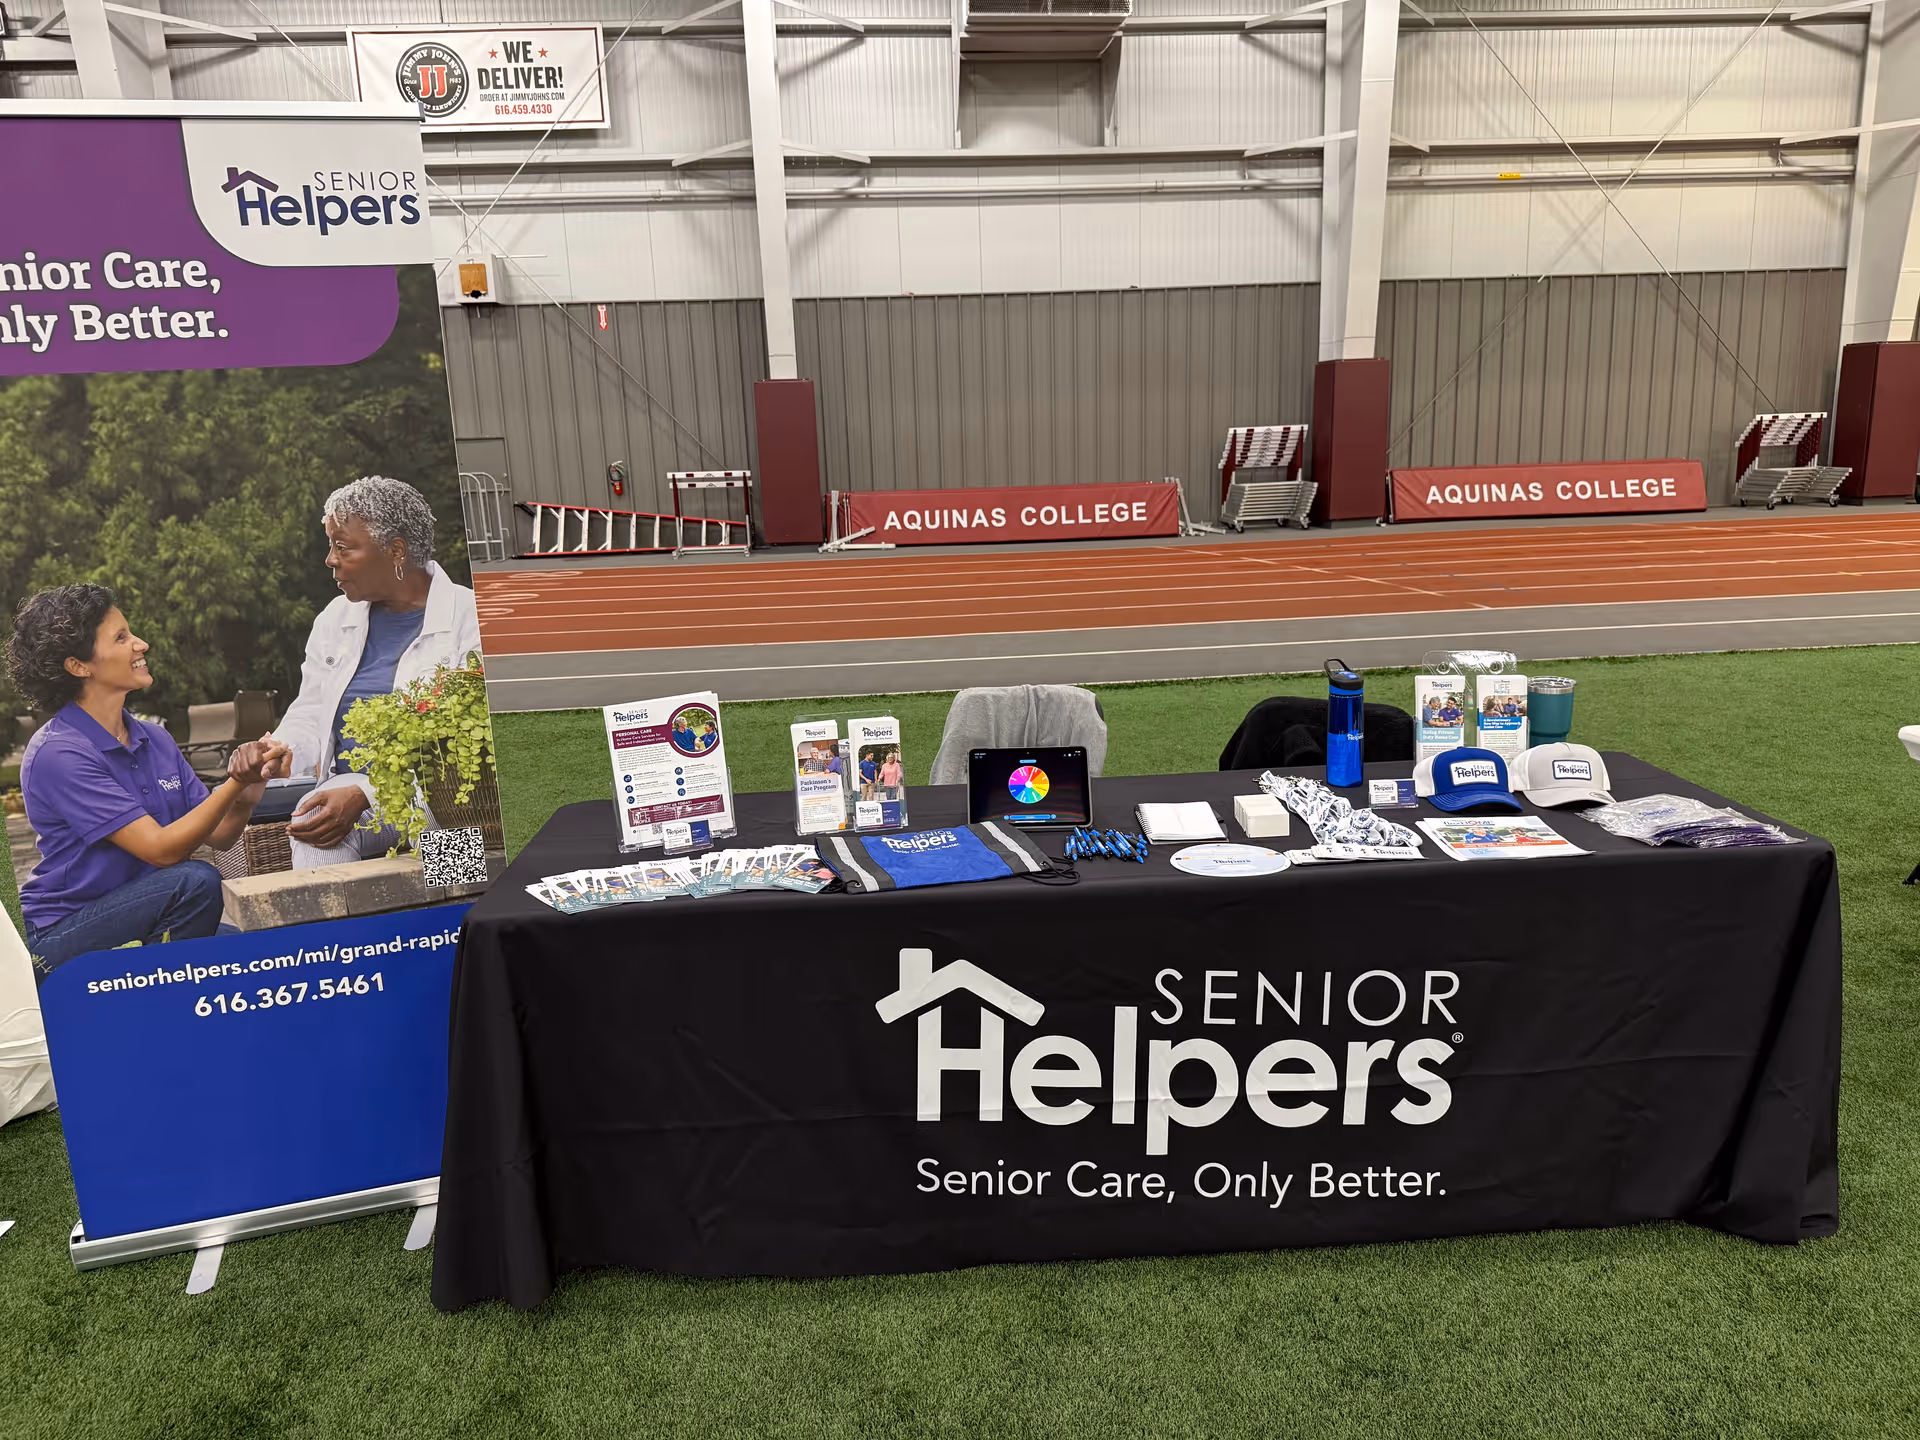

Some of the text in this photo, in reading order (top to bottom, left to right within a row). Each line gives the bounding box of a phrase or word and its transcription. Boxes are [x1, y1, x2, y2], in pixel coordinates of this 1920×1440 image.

[402, 49, 461, 77] JIMMY JOHN'S
[502, 41, 534, 63] WE
[417, 64, 447, 98] JJ
[477, 66, 564, 90] DELIVER!
[480, 92, 565, 102] ORDER AT JIMMYJOHNS.COM
[495, 103, 552, 115] 616.459.4330
[314, 171, 416, 192] SENIOR
[237, 185, 420, 236] Helpers
[103, 251, 221, 294] Care,
[69, 304, 229, 341] Better.
[1426, 477, 1677, 505] AQUINAS COLLEGE
[883, 501, 1147, 531] AQUINAS COLLEGE
[615, 712, 649, 722] Helpers
[800, 778, 832, 786] Parkinson's
[1457, 768, 1495, 778] Helpers
[1558, 766, 1589, 775] Helpers
[887, 833, 957, 850] Helpers
[913, 830, 952, 840] SENIOR
[193, 972, 385, 1017] 616.367.5461
[1150, 968, 1460, 1025] SENIOR
[916, 1005, 1454, 1156] Helpers
[916, 1158, 1446, 1209] Senior Care, Only Better.
